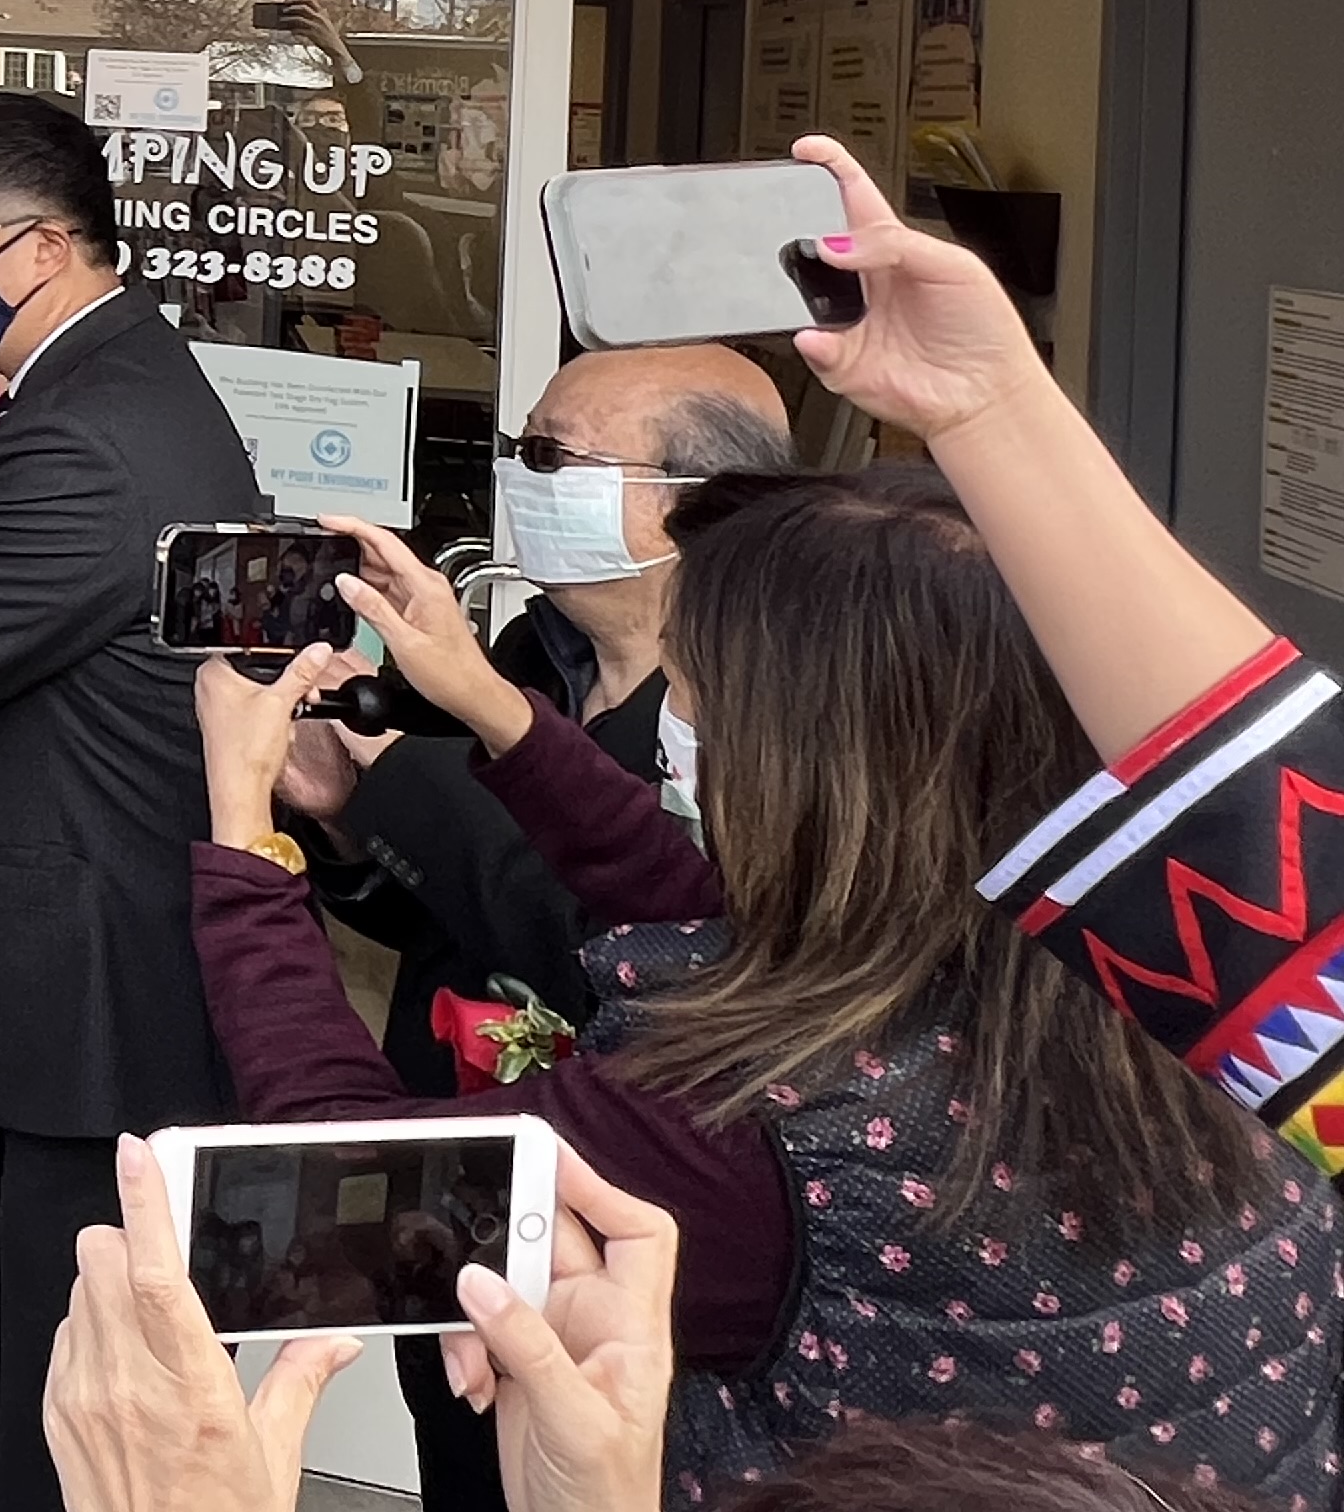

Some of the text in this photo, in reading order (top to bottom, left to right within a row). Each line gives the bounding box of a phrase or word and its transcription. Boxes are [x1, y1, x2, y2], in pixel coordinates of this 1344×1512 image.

[303, 141, 393, 199] UP
[207, 204, 379, 245] CIRCLES
[142, 247, 357, 290] 323-8388
